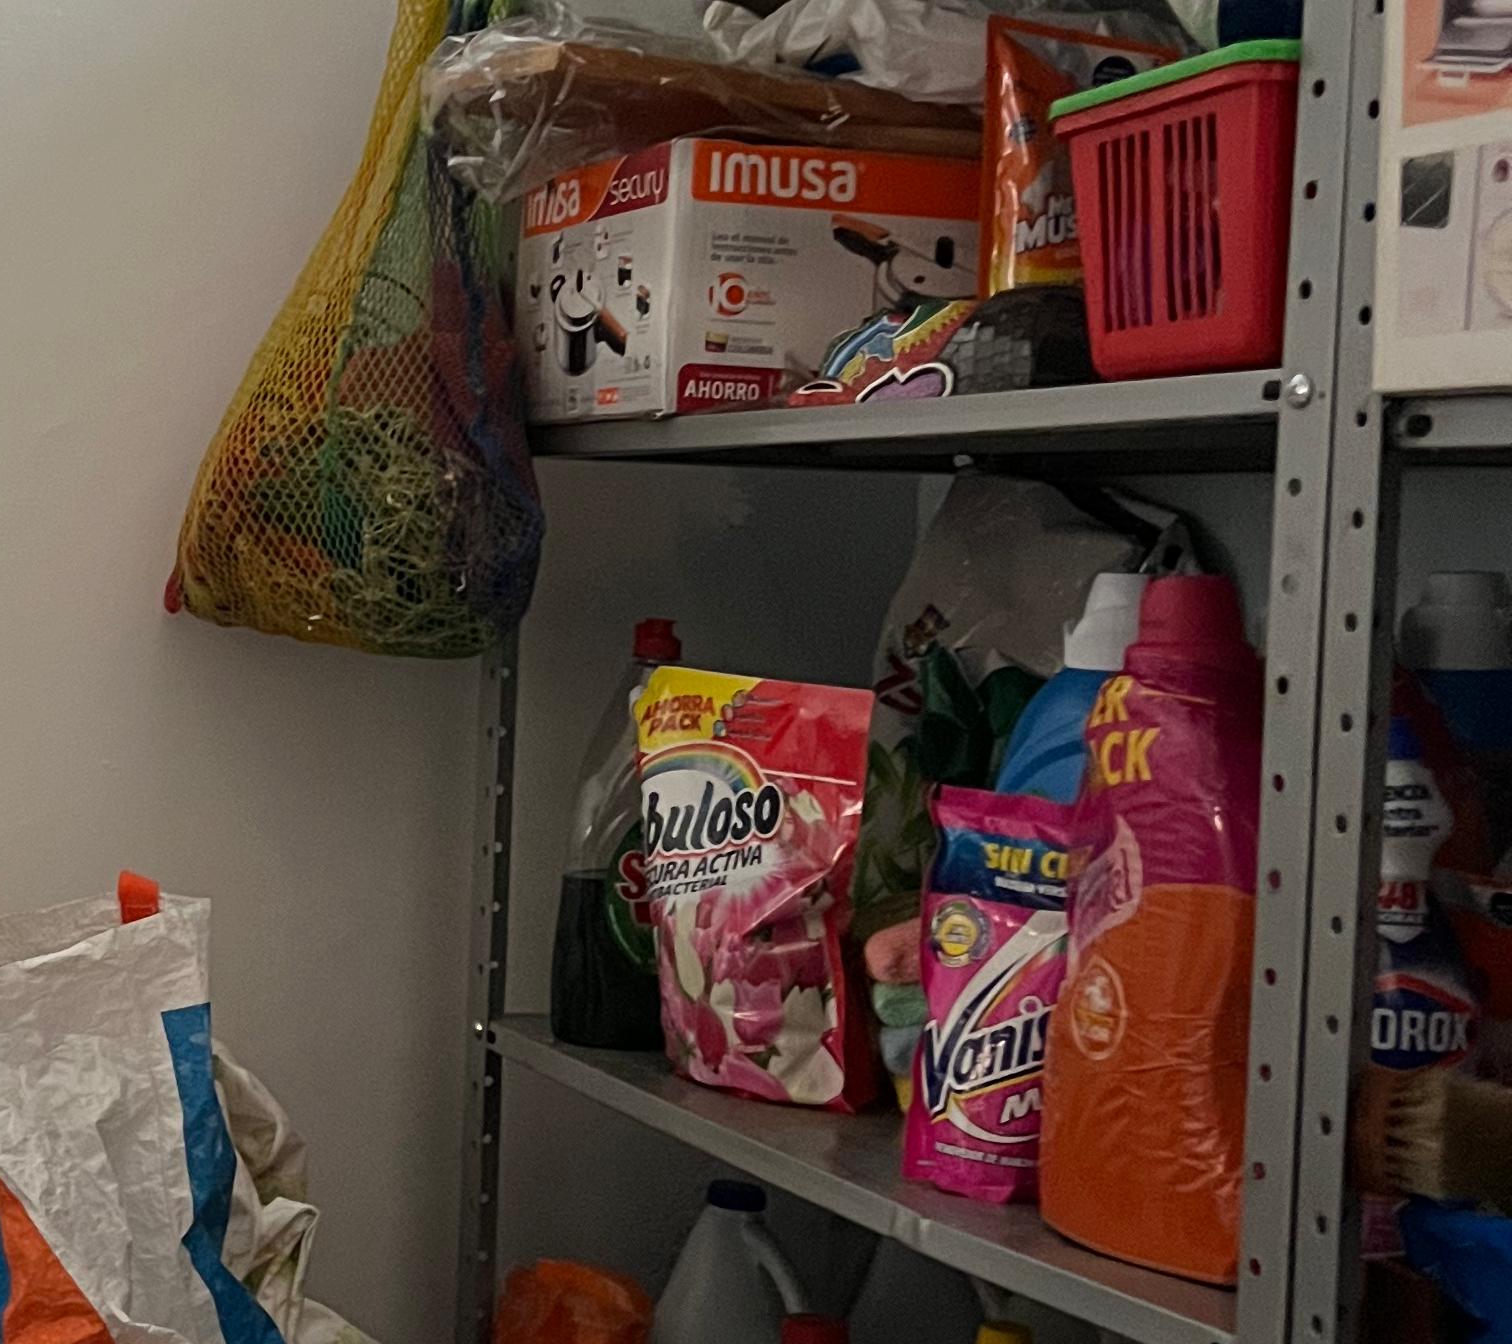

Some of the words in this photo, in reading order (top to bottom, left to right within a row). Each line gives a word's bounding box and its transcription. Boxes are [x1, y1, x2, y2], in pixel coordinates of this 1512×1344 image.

[683, 379, 760, 401] AHORRO
[648, 714, 702, 738] PACK
[693, 844, 763, 876] ACTIVA
